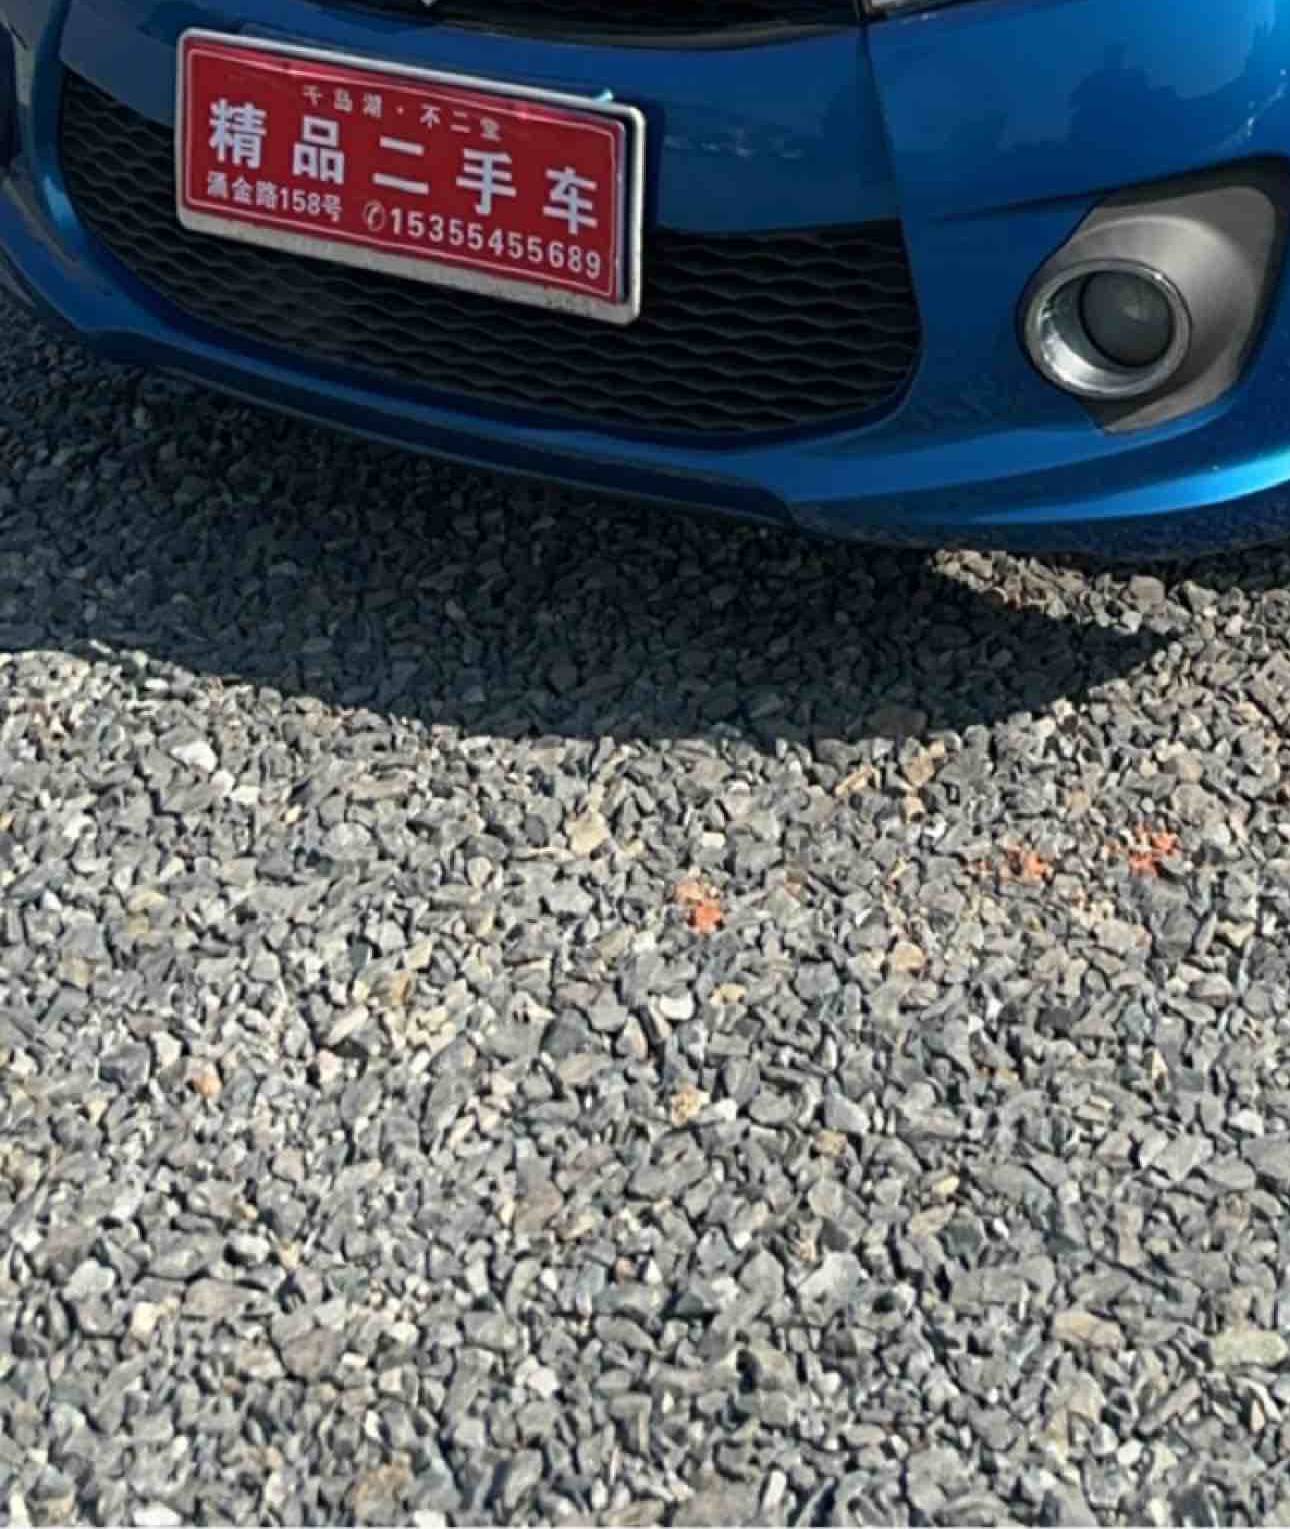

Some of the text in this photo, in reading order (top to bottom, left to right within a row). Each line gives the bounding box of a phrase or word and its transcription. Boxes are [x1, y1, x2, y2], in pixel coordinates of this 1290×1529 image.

[208, 98, 599, 237] 精品二手车
[390, 207, 601, 280] 15355455689
